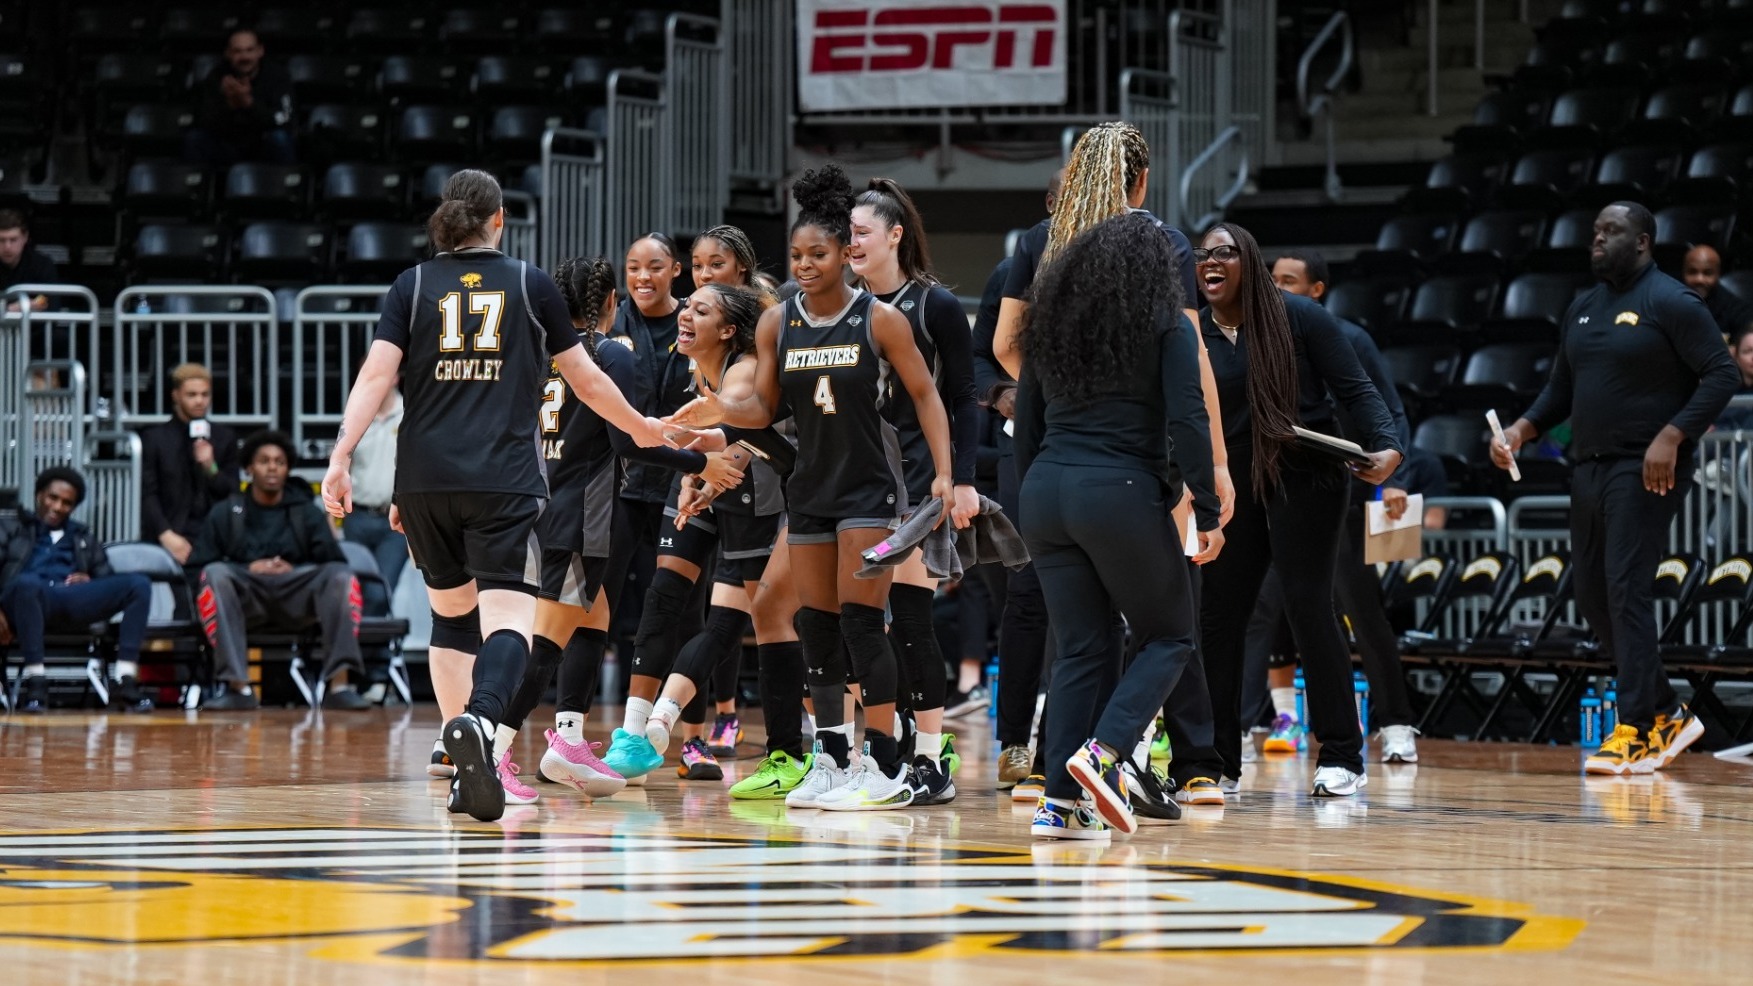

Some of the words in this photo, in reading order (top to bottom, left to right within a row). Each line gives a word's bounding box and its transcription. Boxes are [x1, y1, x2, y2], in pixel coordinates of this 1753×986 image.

[810, 5, 1057, 75] ESPN
[439, 291, 504, 352] 17
[435, 359, 503, 381] CROWLEY
[784, 344, 860, 372] RETRIEVERS
[539, 377, 565, 434] 2
[814, 375, 837, 414] 4
